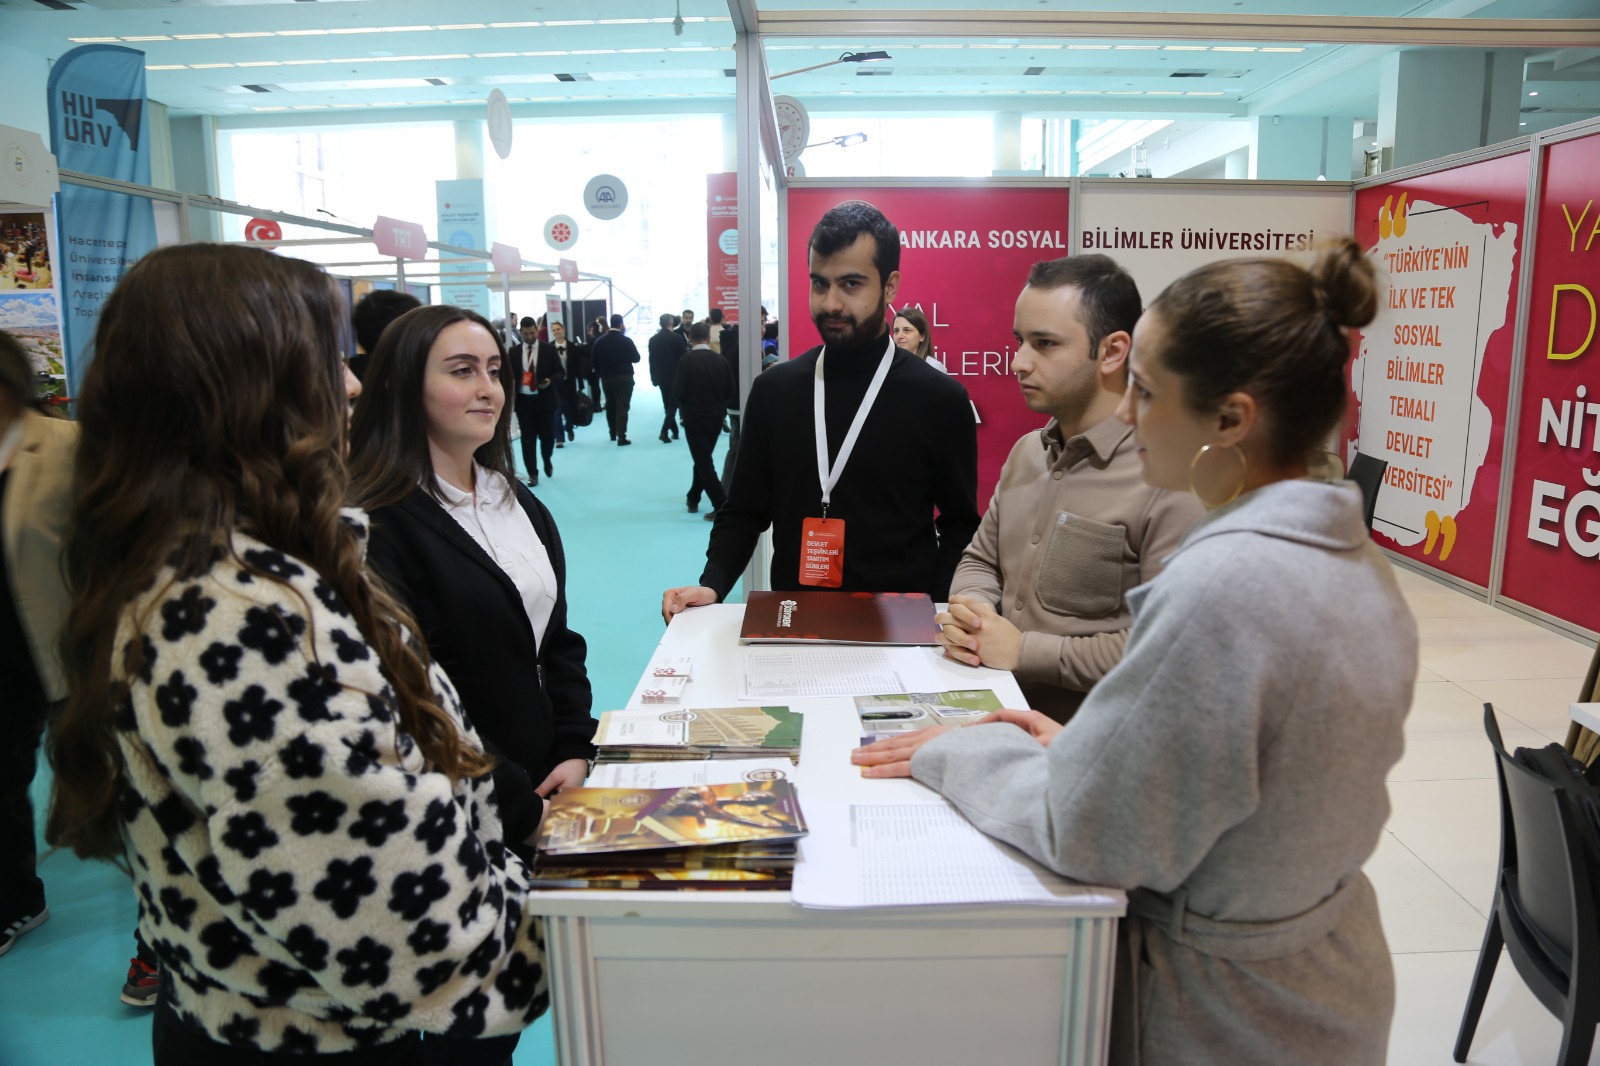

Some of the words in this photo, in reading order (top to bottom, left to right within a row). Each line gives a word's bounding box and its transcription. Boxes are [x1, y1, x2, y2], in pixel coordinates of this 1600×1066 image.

[62, 90, 94, 119] HU
[899, 230, 981, 249] ANKARA
[988, 230, 1066, 249] SOSYAL
[1082, 227, 1174, 249] BİLİMLER
[1181, 228, 1314, 251] ÜNİVERSİTESİ
[1389, 284, 1408, 309] İLK
[1411, 287, 1427, 309] VE
[1430, 286, 1456, 309] TEK
[1394, 324, 1442, 347] SOSYAL
[1387, 355, 1445, 385] BİLİMLER
[1390, 395, 1435, 422] TEMALI
[1386, 430, 1433, 459] DEVLET
